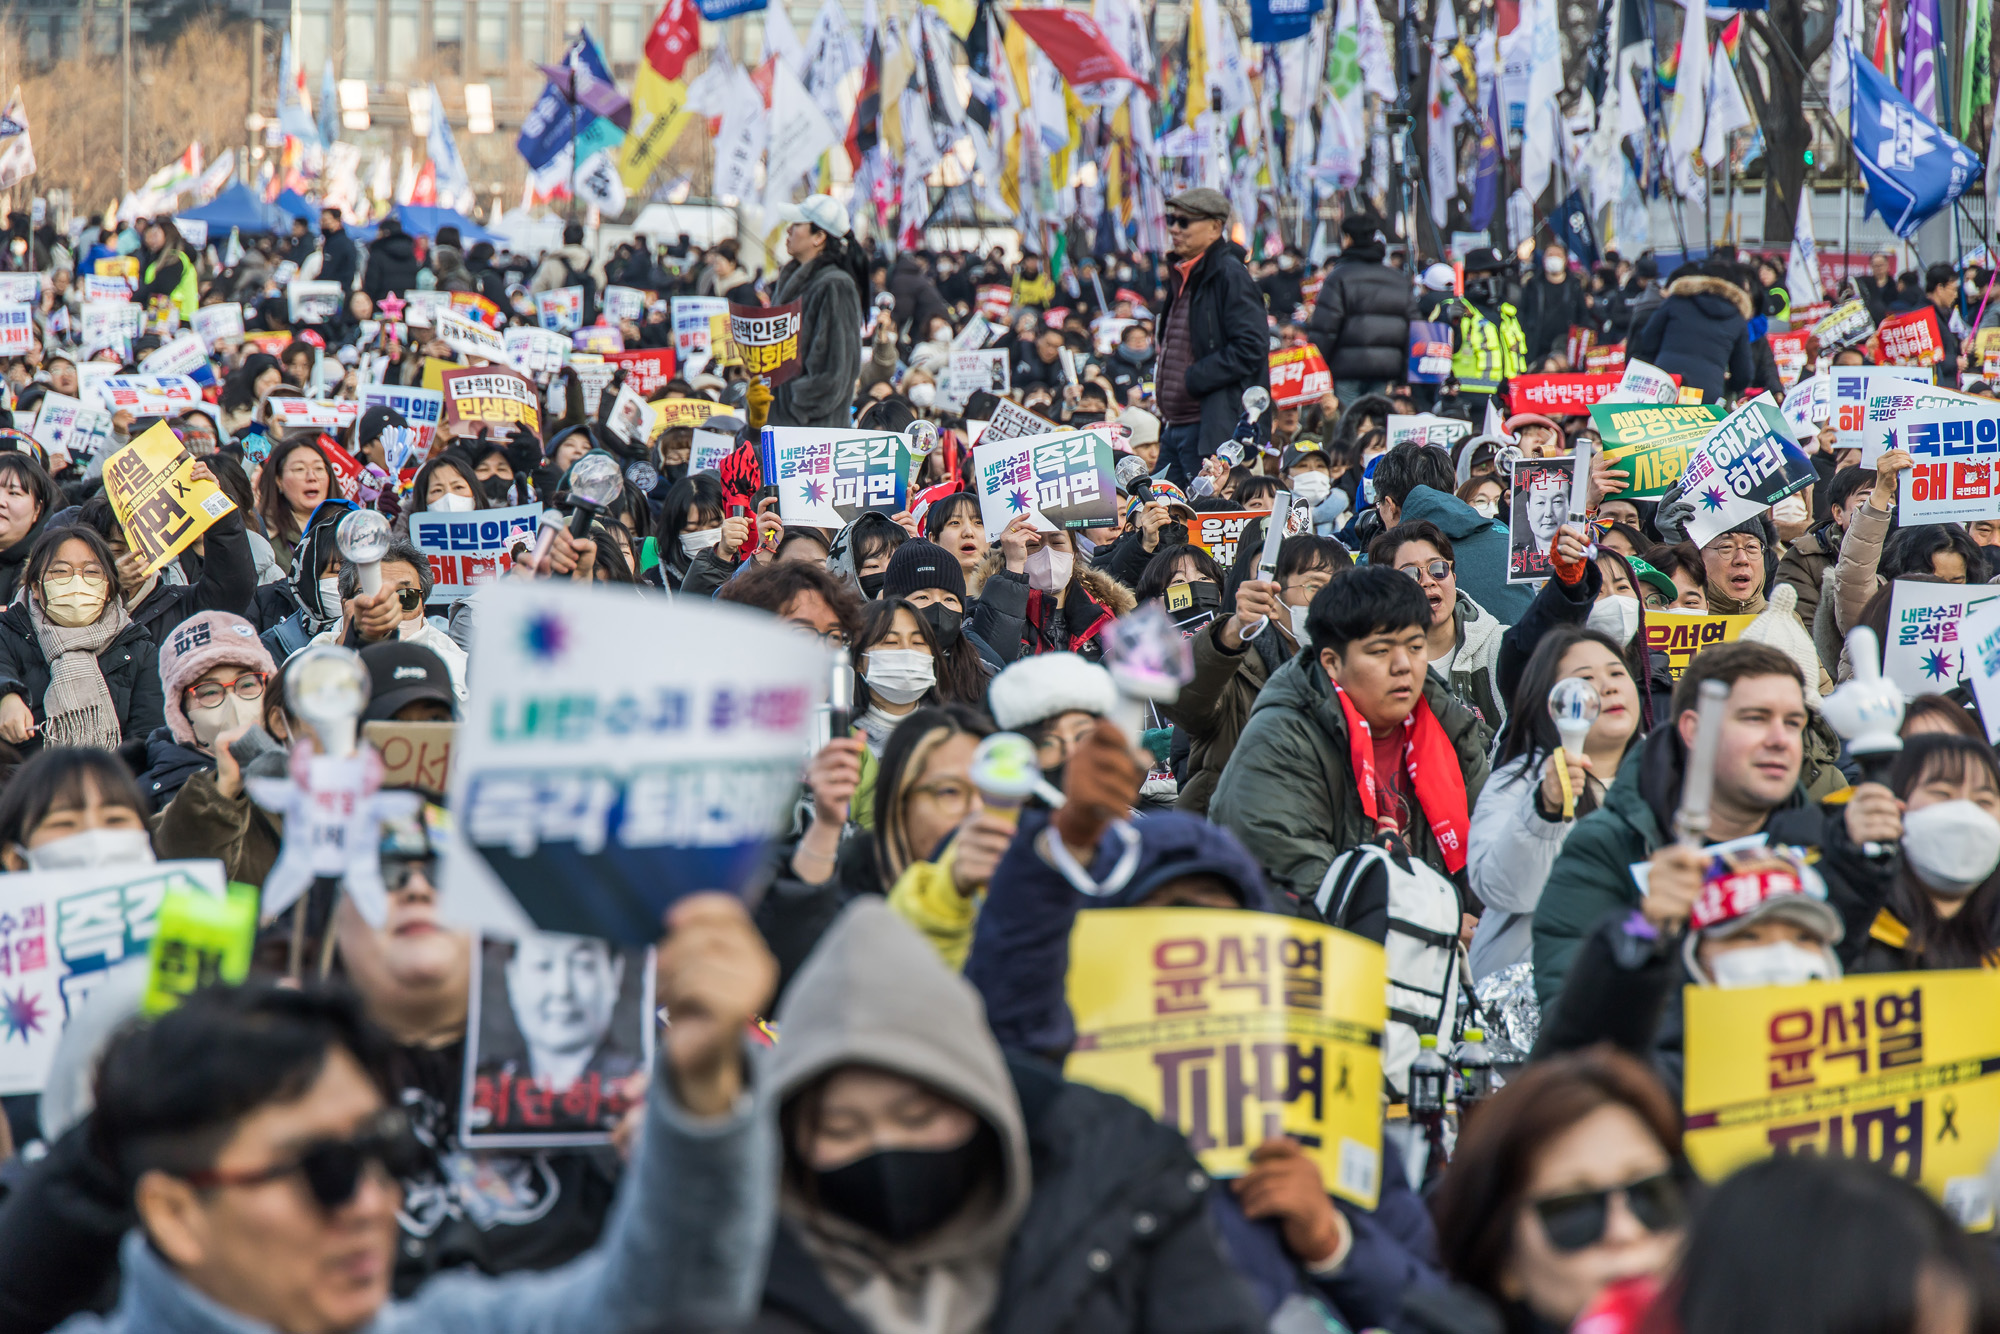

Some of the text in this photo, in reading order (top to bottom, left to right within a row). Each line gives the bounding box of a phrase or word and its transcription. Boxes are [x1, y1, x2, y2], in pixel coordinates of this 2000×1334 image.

[1526, 381, 1593, 403] 대한민국은
[1870, 396, 1914, 409] 내란동조
[665, 403, 711, 423] 윤석열
[1611, 404, 1721, 443] 생명안전
[1709, 404, 1771, 467] 해체
[781, 443, 831, 460] 내란수괴
[835, 437, 899, 473] 즉각
[984, 450, 1030, 478] 내란수괴
[1035, 434, 1098, 475] 즉각
[781, 456, 830, 479] 윤석열
[1727, 435, 1788, 496] 하라
[834, 473, 897, 508] 파면
[985, 463, 1032, 496] 윤석열
[1038, 468, 1100, 511] 파면
[1514, 469, 1574, 492] 내란수
[1956, 485, 1987, 496] 국민의힘
[1201, 518, 1252, 542] 윤석
[1511, 549, 1555, 573] 처단
[1901, 603, 1962, 623] 내란수괴
[174, 630, 212, 657] 파면
[394, 666, 427, 680] Jeep
[1152, 935, 1327, 1016] 윤석열
[1768, 985, 1923, 1091] 윤석열
[1152, 1042, 1327, 1152] 파면
